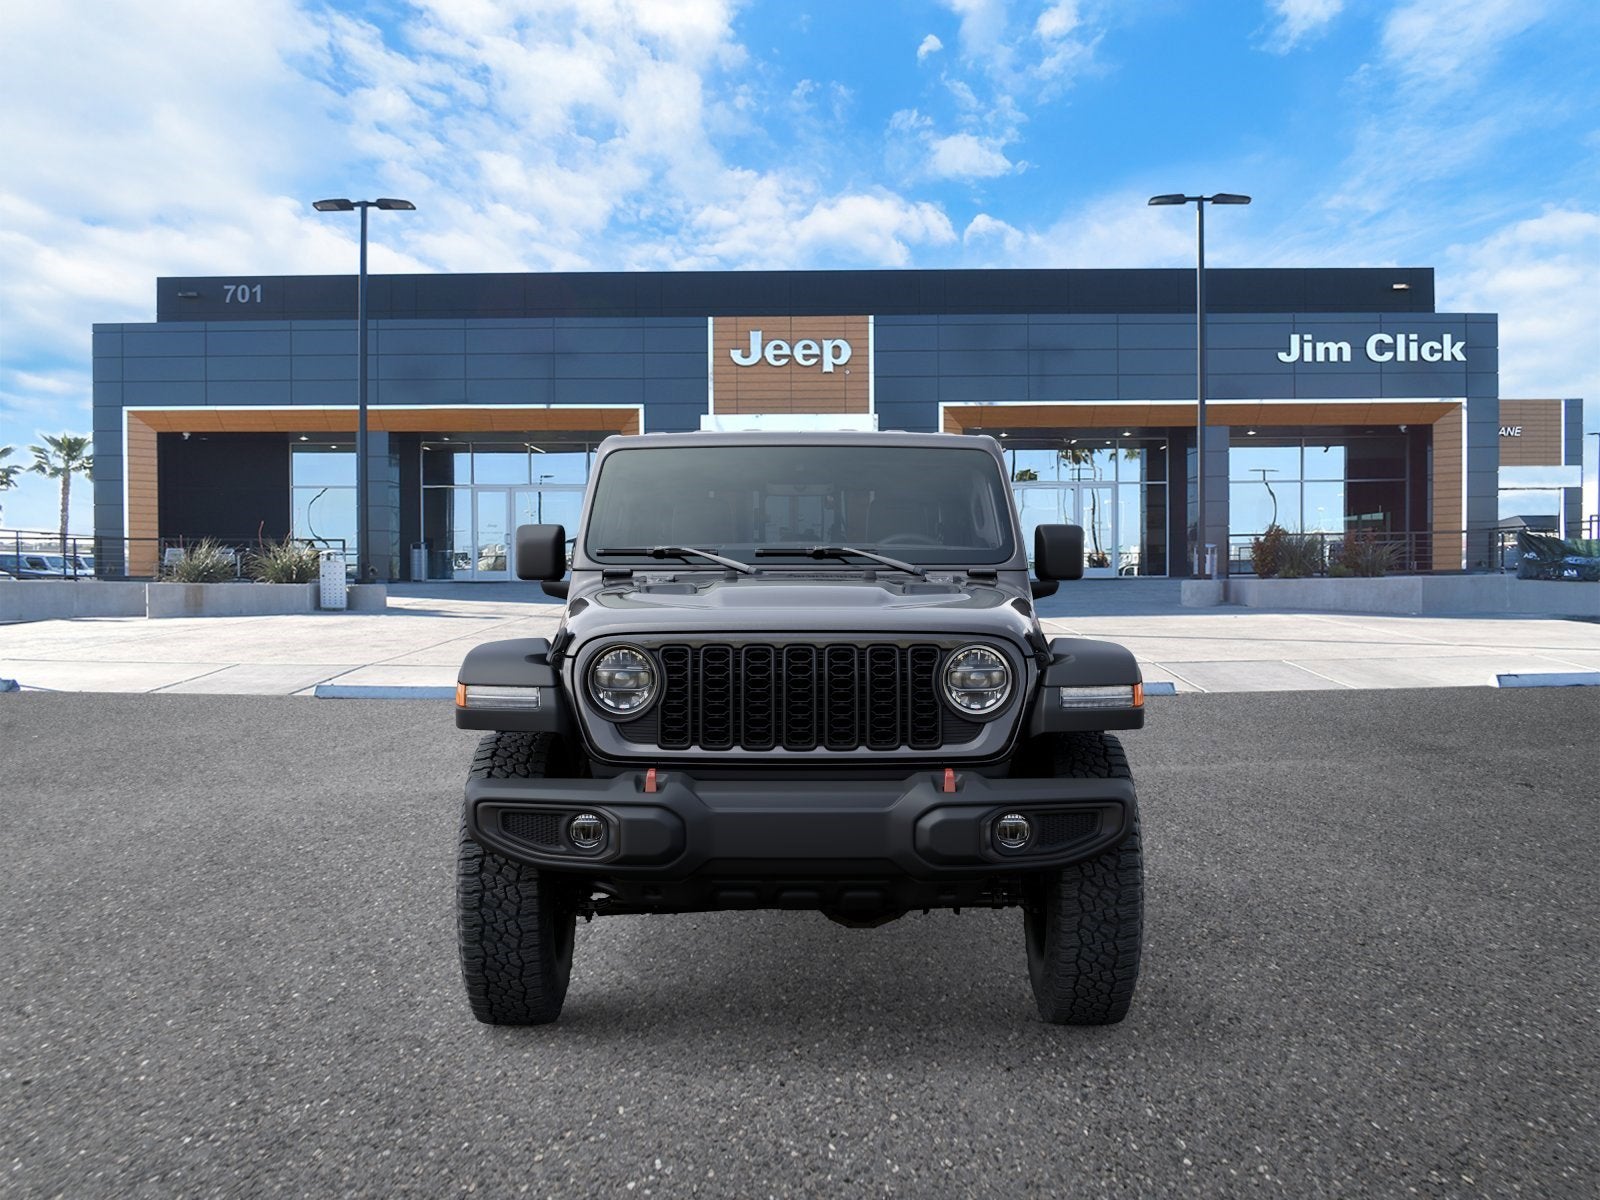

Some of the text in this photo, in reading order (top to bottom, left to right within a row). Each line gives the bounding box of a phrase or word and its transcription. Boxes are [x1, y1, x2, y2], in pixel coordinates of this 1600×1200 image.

[223, 284, 262, 304] 701
[729, 330, 852, 374] Jeep
[1277, 333, 1467, 363] Jim Click
